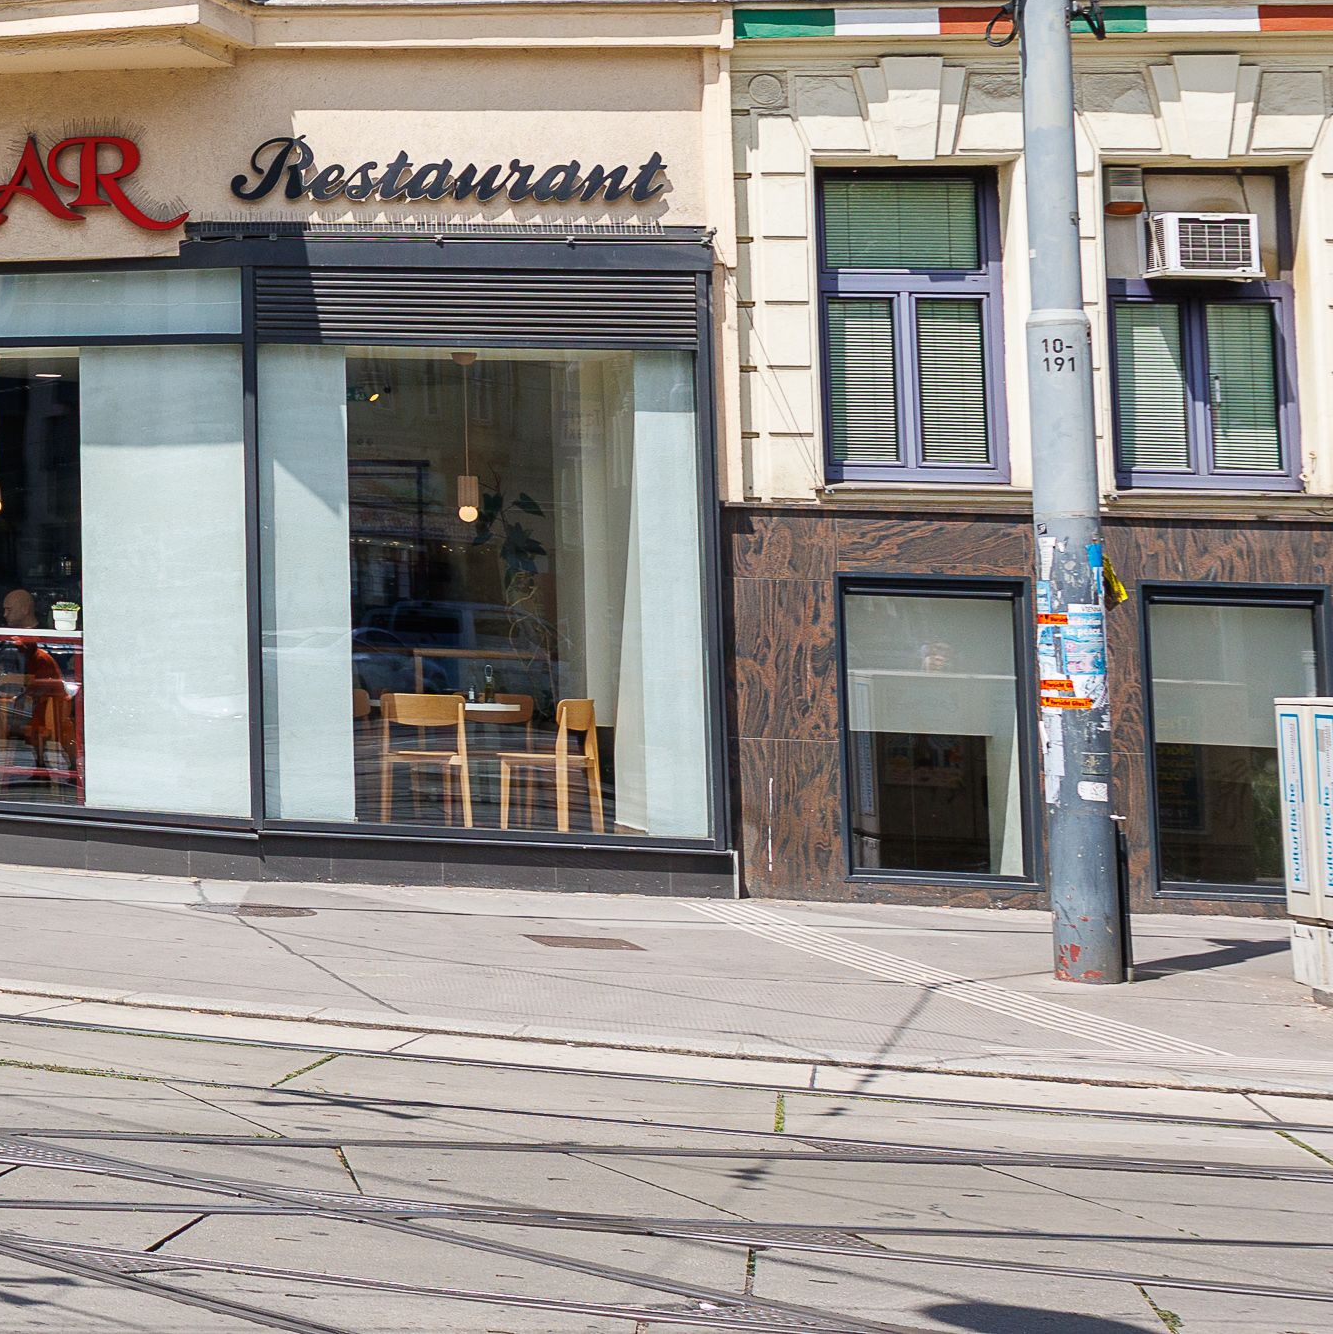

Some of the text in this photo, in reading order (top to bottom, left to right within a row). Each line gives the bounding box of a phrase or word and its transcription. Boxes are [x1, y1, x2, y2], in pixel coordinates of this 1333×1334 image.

[230, 134, 668, 204] Restaurant
[1041, 338, 1074, 354] 10-
[1042, 356, 1076, 372] 191
